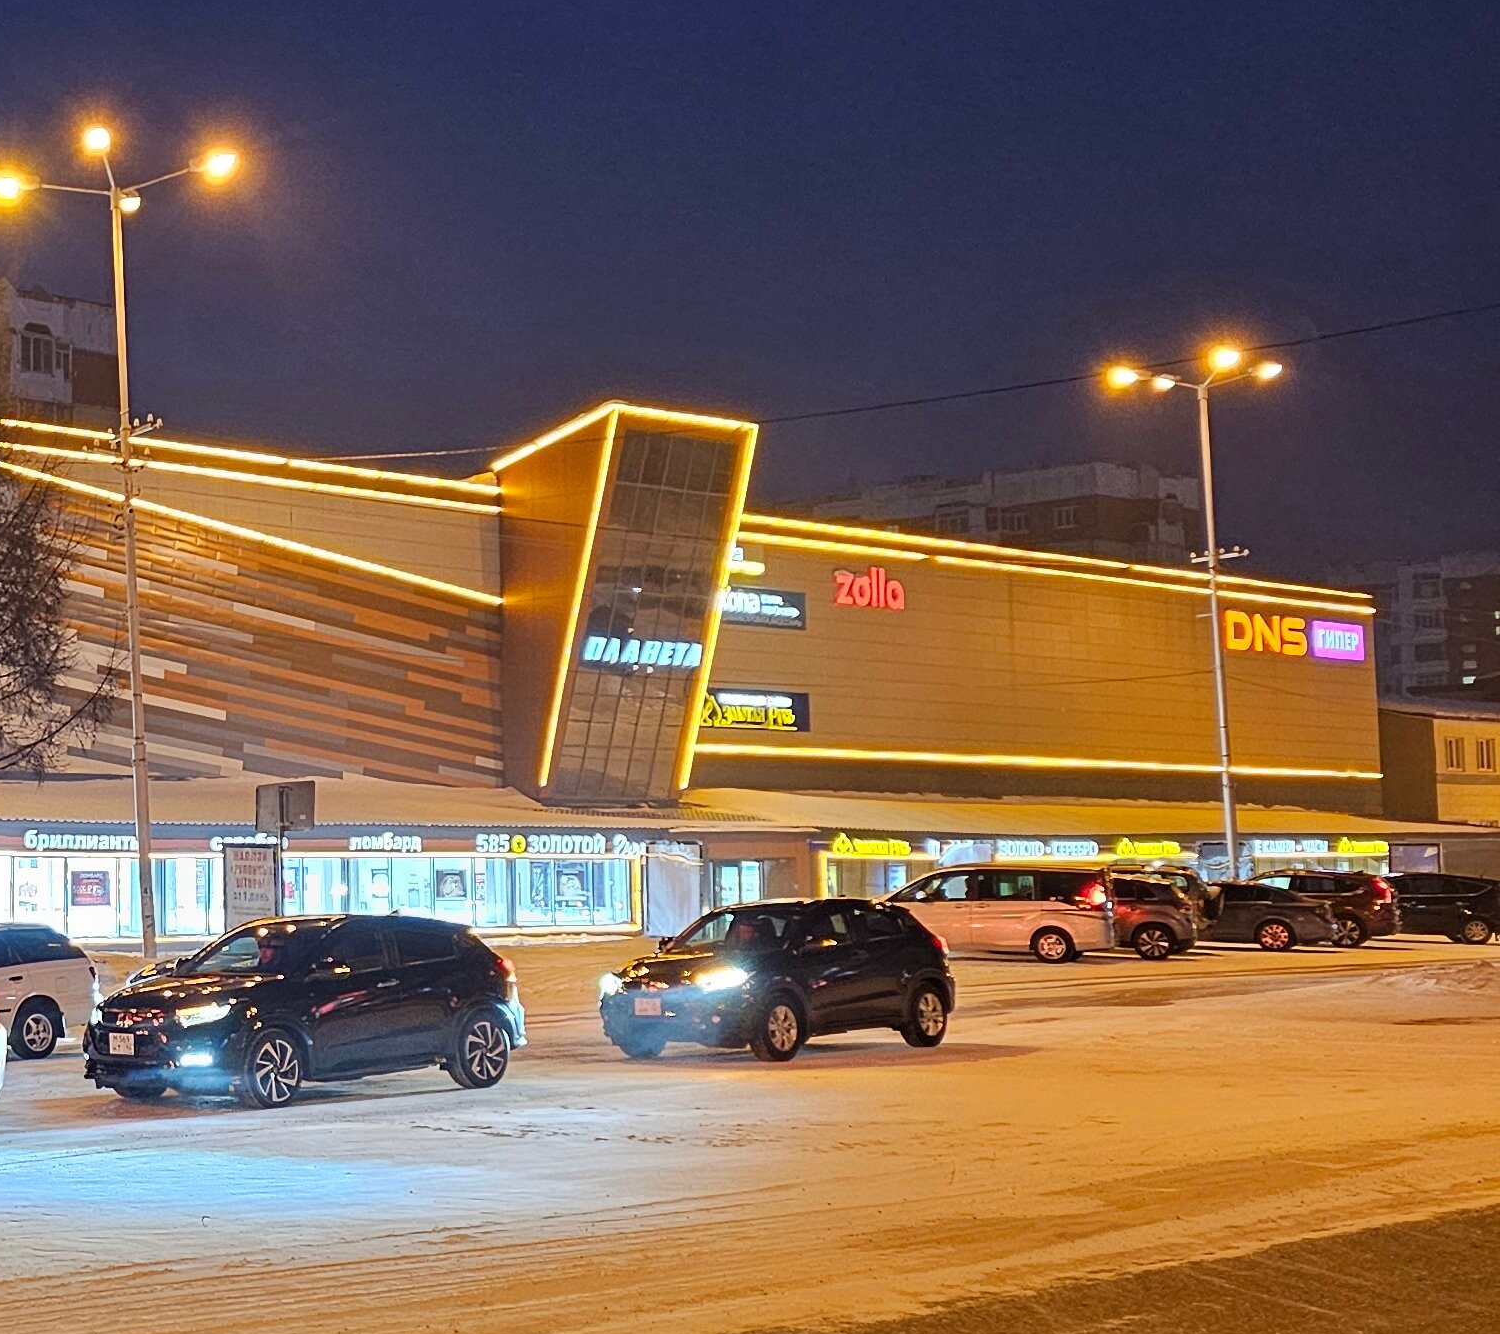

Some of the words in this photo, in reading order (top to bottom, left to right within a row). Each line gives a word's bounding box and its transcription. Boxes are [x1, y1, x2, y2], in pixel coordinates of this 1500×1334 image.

[834, 567, 905, 610] zolla
[1225, 610, 1308, 657] DNS
[1316, 628, 1360, 652] ГИПЕР
[583, 635, 703, 668] ПЛАНЕТА
[349, 831, 422, 854] ломбард
[475, 833, 511, 853] 585
[527, 833, 606, 855] ЗОЛОТОЙ
